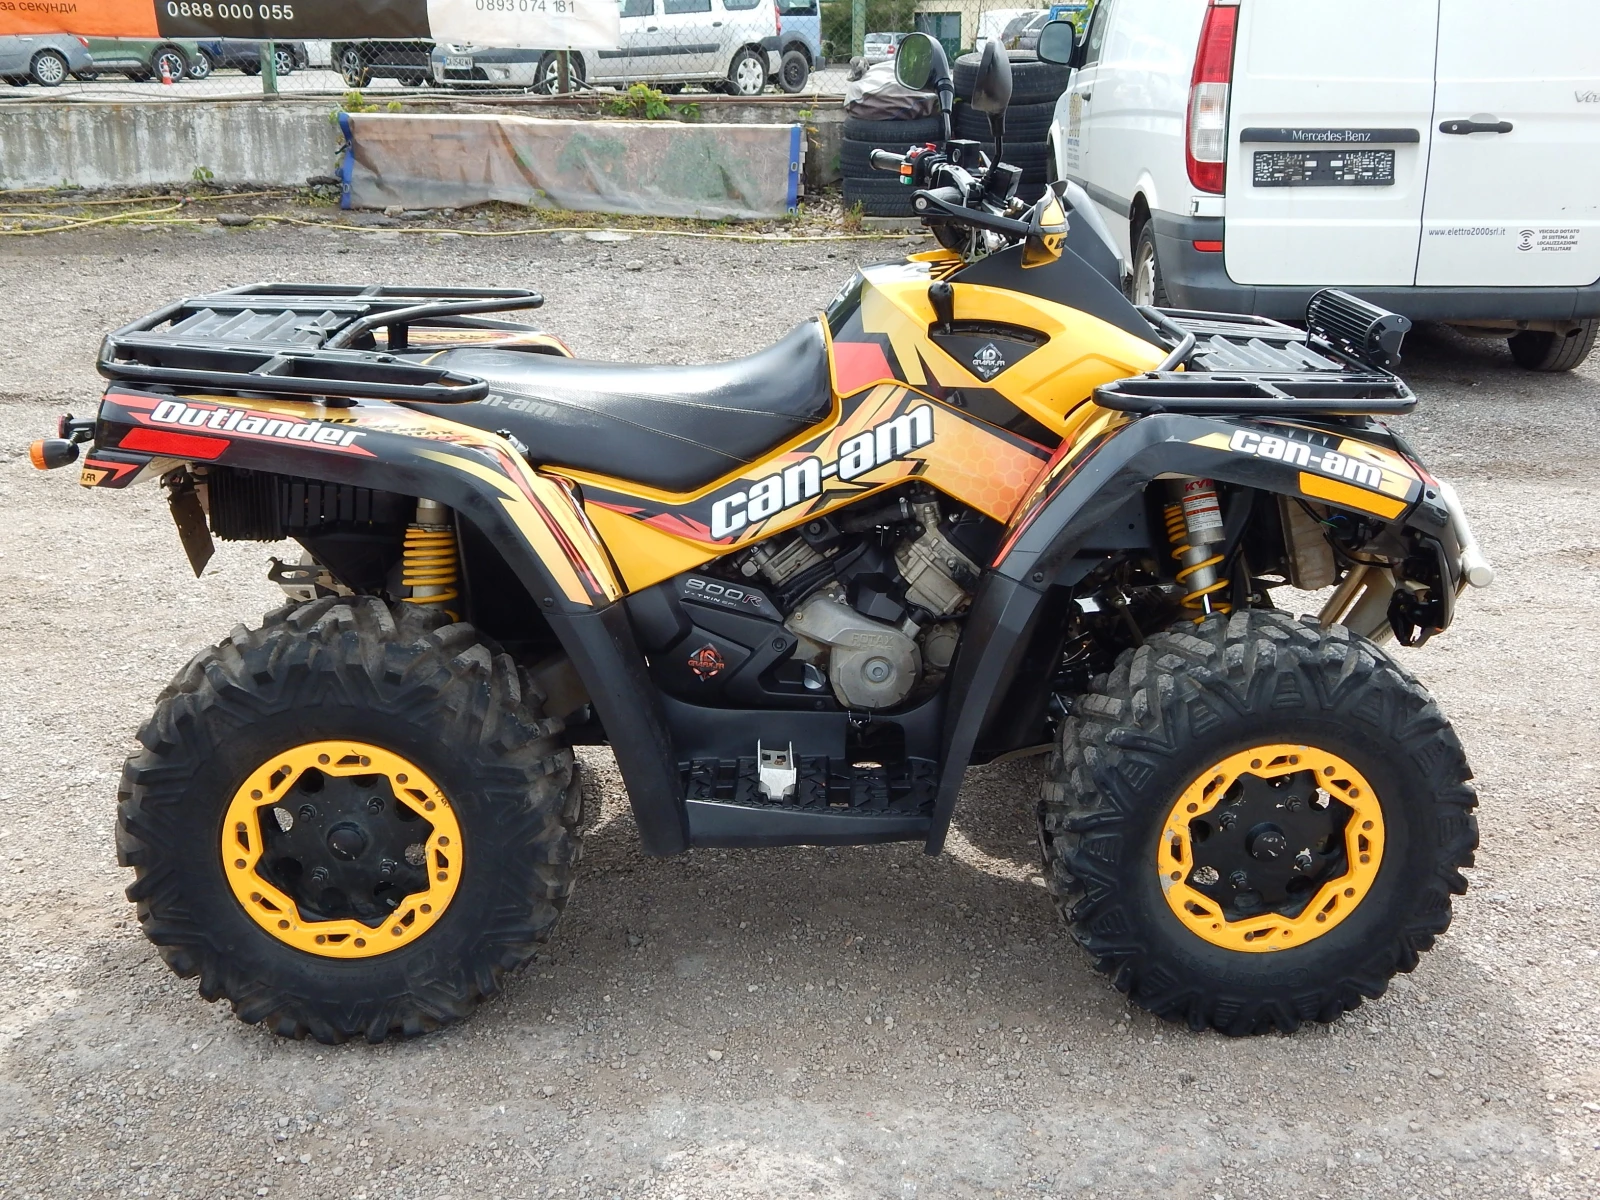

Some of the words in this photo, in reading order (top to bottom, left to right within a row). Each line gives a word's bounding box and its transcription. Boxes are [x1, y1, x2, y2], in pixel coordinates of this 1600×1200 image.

[19, 3, 77, 13] секунди
[167, 1, 213, 17] 0888
[218, 4, 252, 19] 000
[259, 5, 294, 20] 055
[475, 0, 515, 11] 0893
[519, 0, 546, 12] 074
[554, 1, 575, 13] 181
[1574, 90, 1600, 103] Vit
[1292, 130, 1371, 142] Mercedes-Benz
[1428, 227, 1506, 236] www.elettro2000srl.it
[480, 394, 558, 418] n-am
[150, 400, 367, 447] Outlander
[1230, 429, 1382, 489] can-am
[711, 404, 933, 539] can-am
[686, 578, 763, 608] 800R
